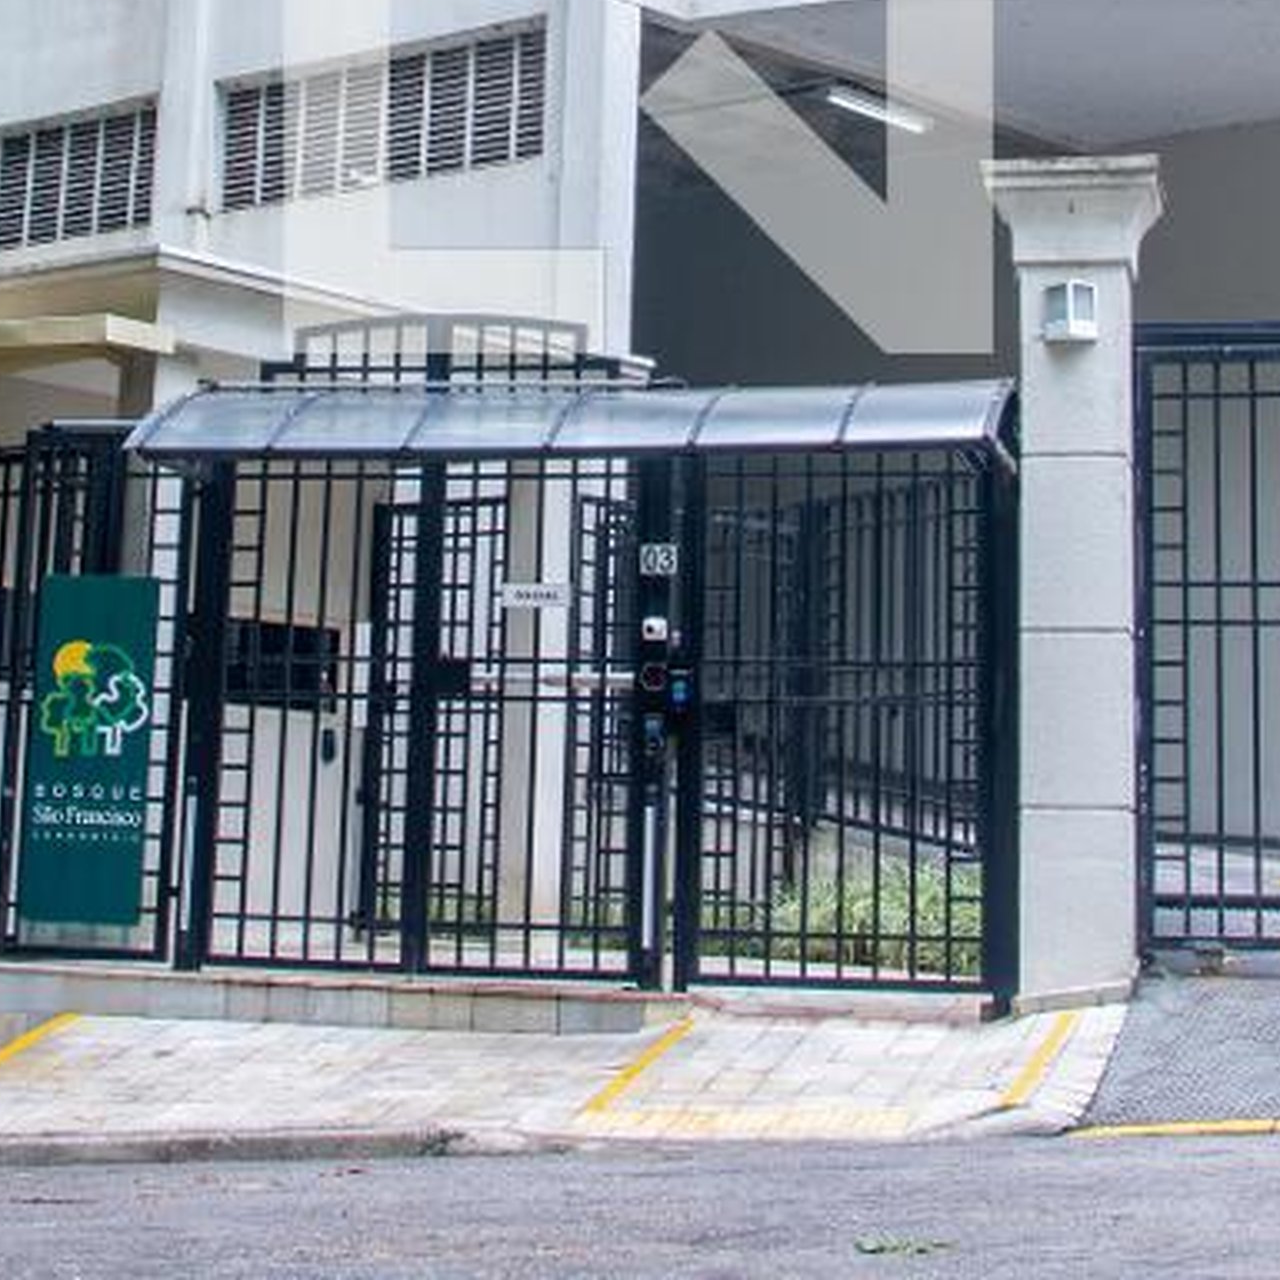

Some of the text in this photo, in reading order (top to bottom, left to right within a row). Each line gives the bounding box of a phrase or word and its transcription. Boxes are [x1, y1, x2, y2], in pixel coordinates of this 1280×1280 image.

[642, 546, 675, 572] 03
[33, 782, 142, 801] BOSQUE
[65, 806, 142, 827] Francisco
